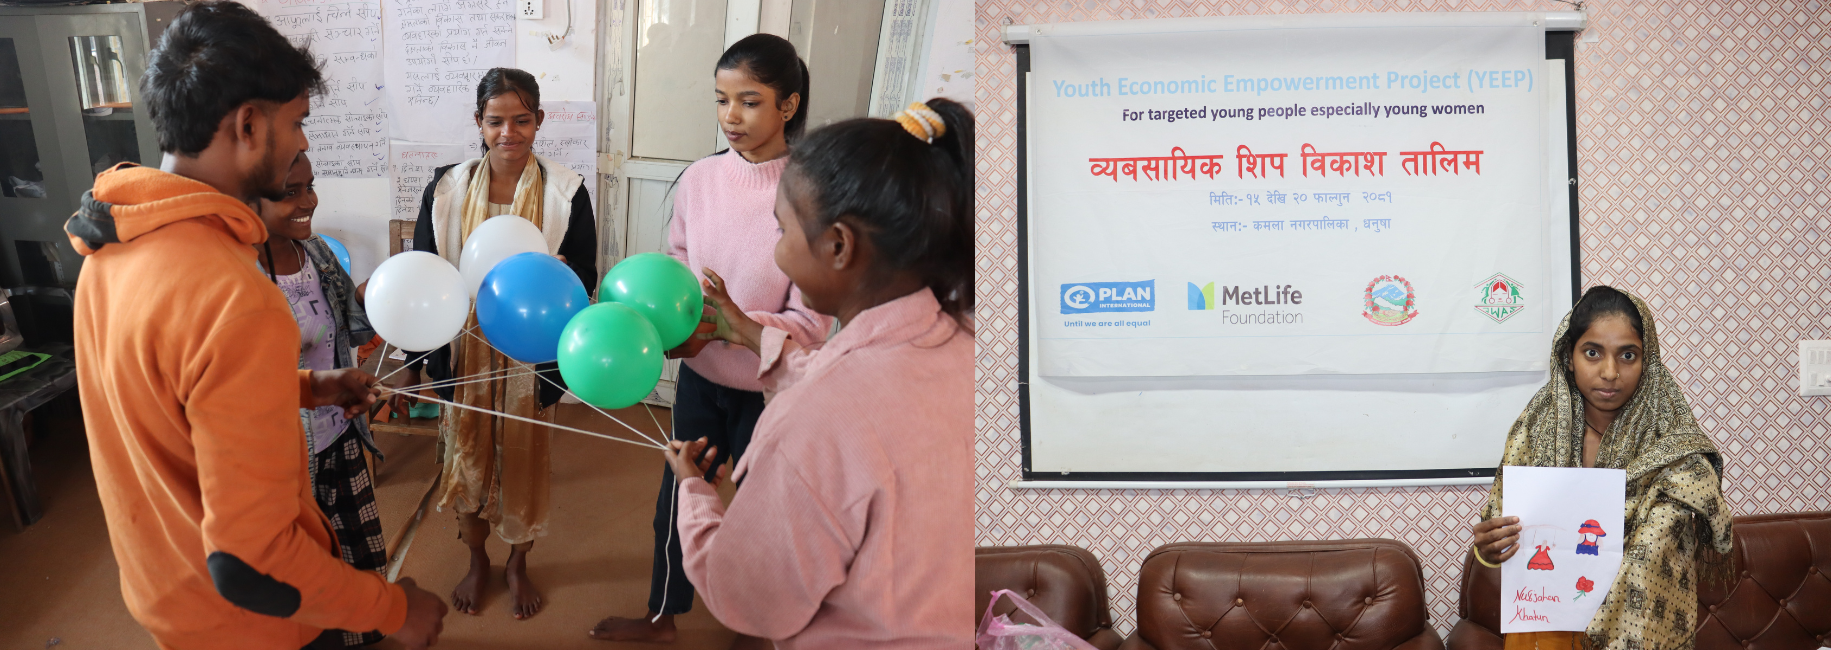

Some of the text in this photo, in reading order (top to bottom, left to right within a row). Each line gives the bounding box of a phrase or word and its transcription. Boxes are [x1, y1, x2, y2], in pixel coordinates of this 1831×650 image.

[1052, 69, 1534, 97] Youth Economic Empowerment Project (YEEP)
[1122, 102, 1485, 122] For targeted young people especially young women
[1089, 141, 1484, 183] व्यबसायिक शिप विकाश तालिम
[1266, 190, 1287, 204] देखि
[1293, 192, 1308, 204] २०
[1313, 192, 1351, 206] फाल्गुन
[1362, 191, 1393, 204] २०८१
[1253, 220, 1285, 231] कमला
[1289, 216, 1349, 231] नगरपालिका
[1363, 218, 1392, 232] धनुषा
[1099, 287, 1151, 301] PLAN
[1222, 284, 1303, 305] MetLife
[1126, 320, 1151, 328] equal
[1222, 309, 1304, 324] Foundation
[1509, 605, 1551, 624] Khatun
